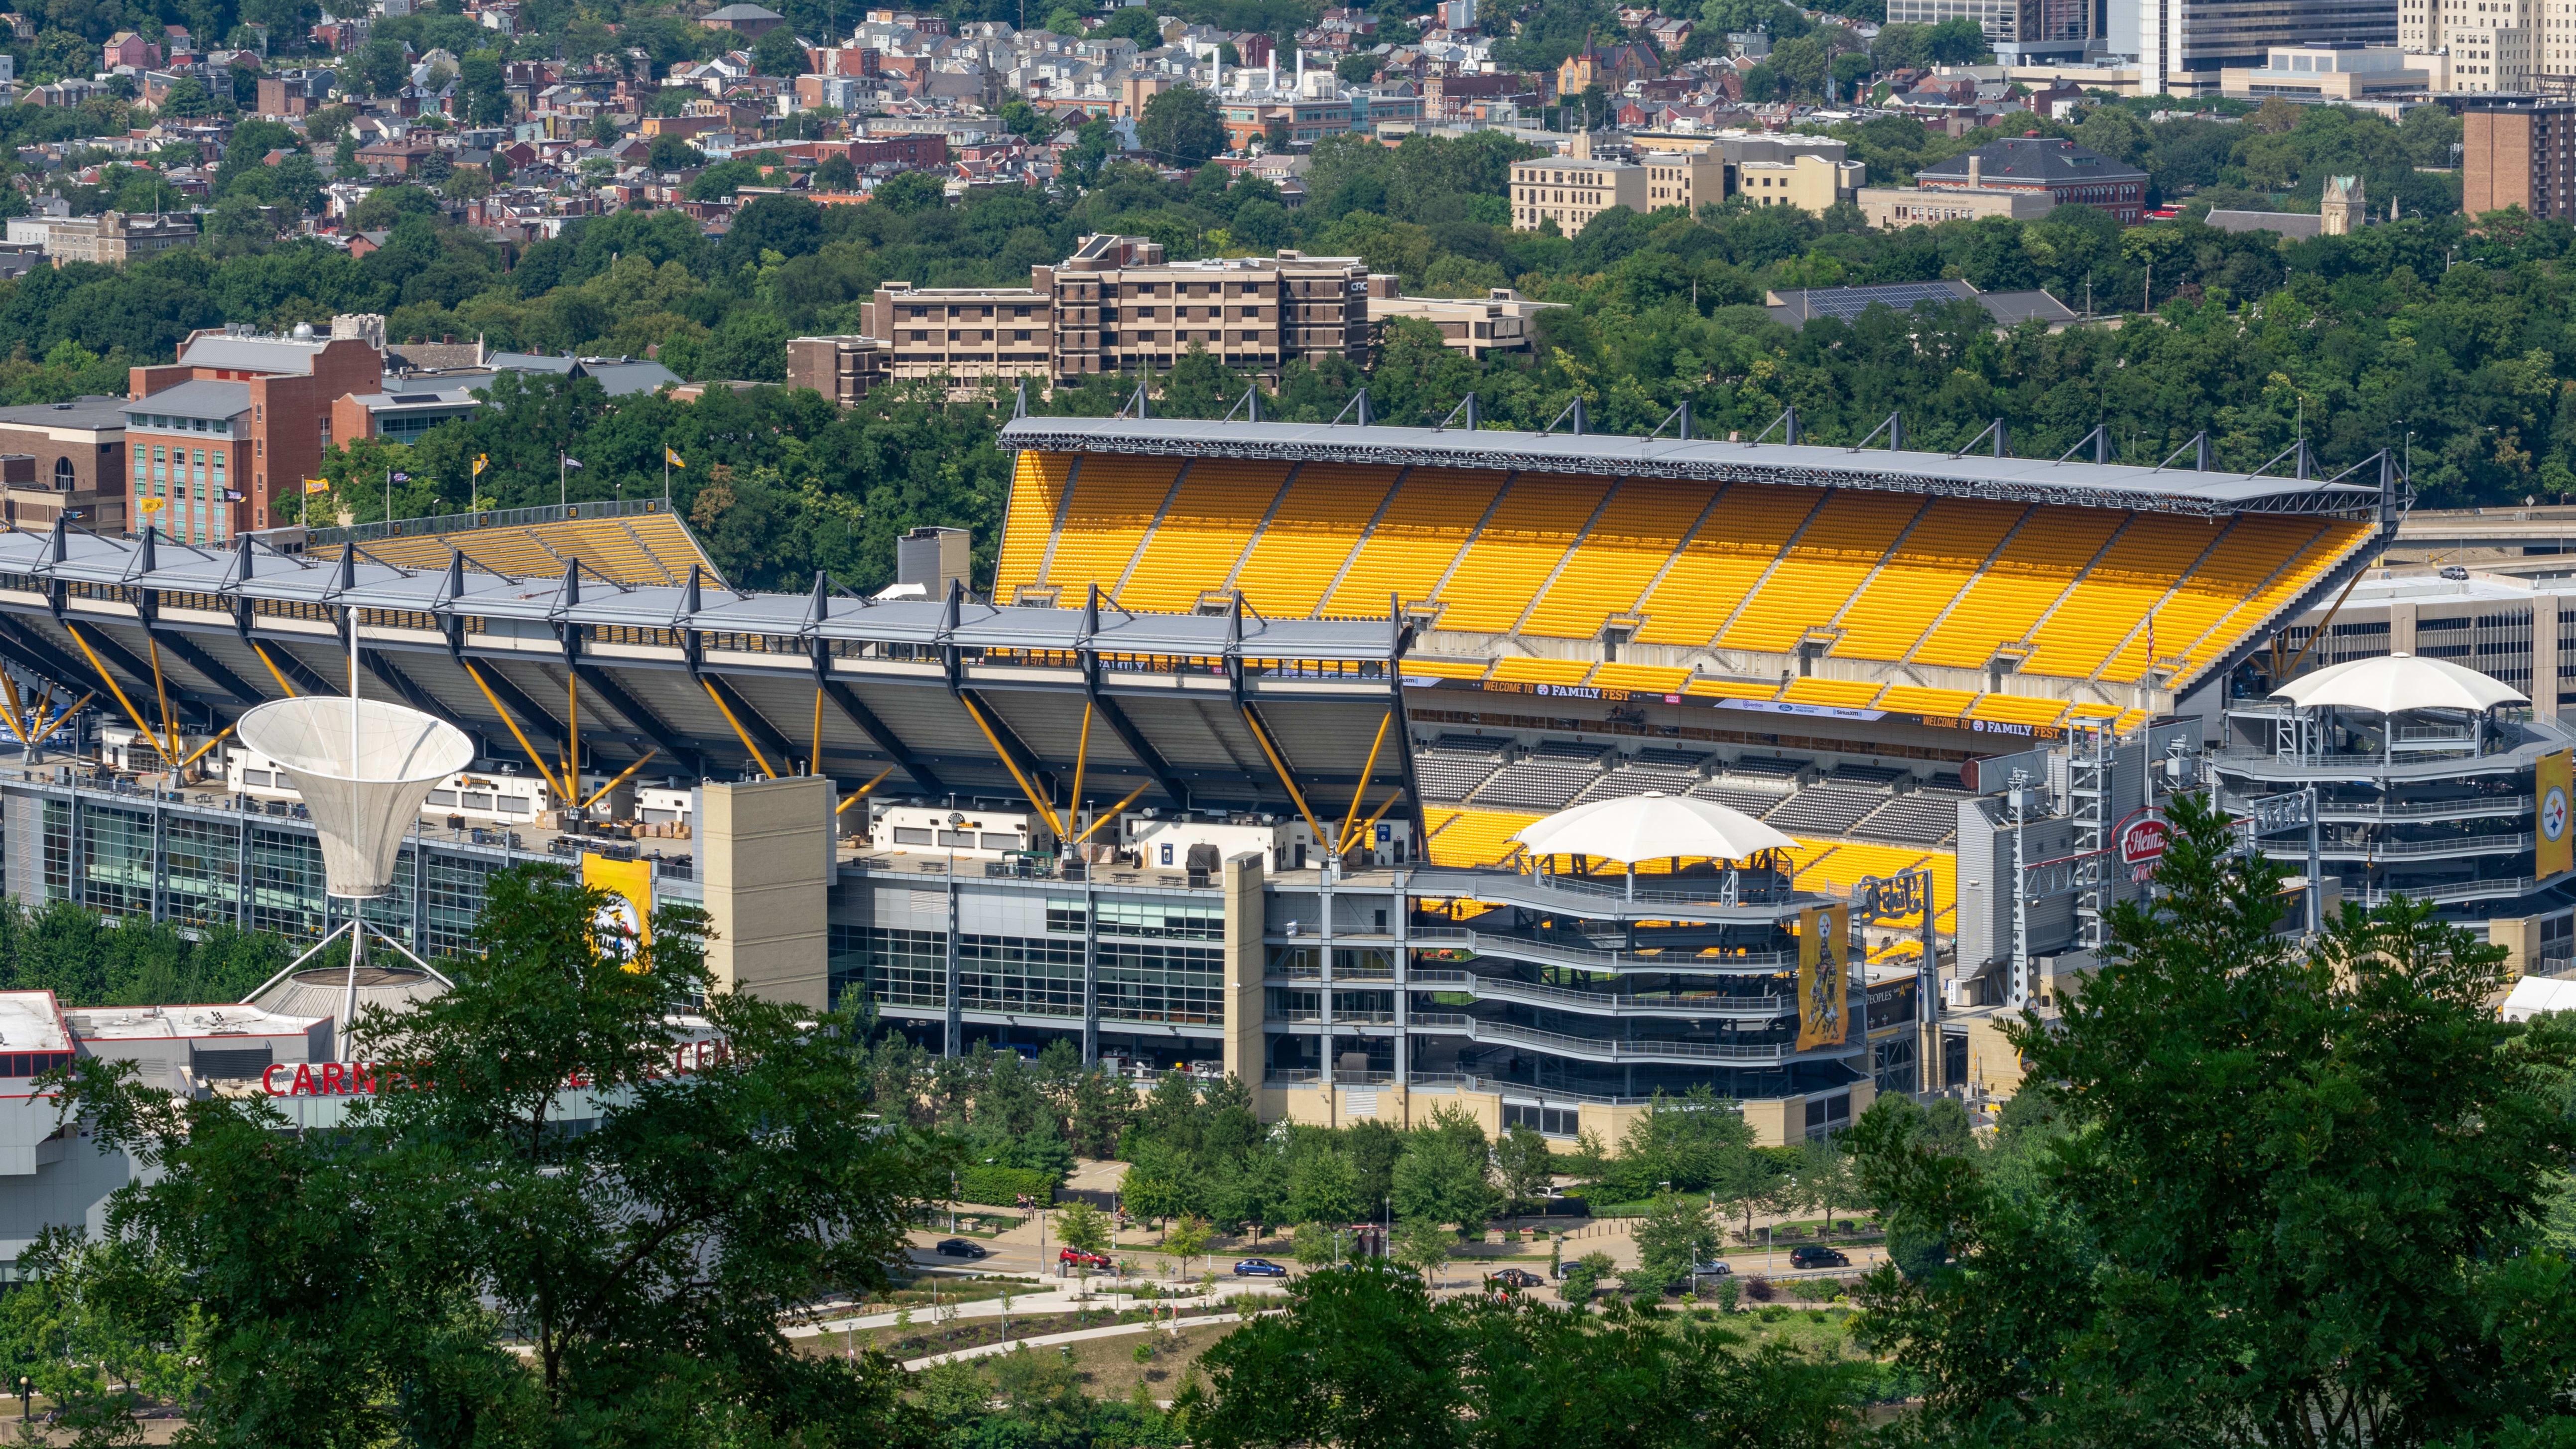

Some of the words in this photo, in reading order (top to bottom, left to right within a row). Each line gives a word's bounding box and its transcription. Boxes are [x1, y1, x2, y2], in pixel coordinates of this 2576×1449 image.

[1483, 681, 1522, 693] WELCOME
[1524, 683, 1534, 693] TO
[1552, 685, 1601, 699] FAMILY
[1602, 689, 1630, 701] FEST
[1923, 716, 1958, 729] WELCOME
[1960, 719, 1970, 729] TO
[1987, 721, 2033, 737] FAMILY
[2034, 728, 2060, 739] FEST
[2128, 827, 2165, 854] Heinz
[1867, 990, 1892, 1005] PEOPLES
[1899, 985, 1906, 998] A
